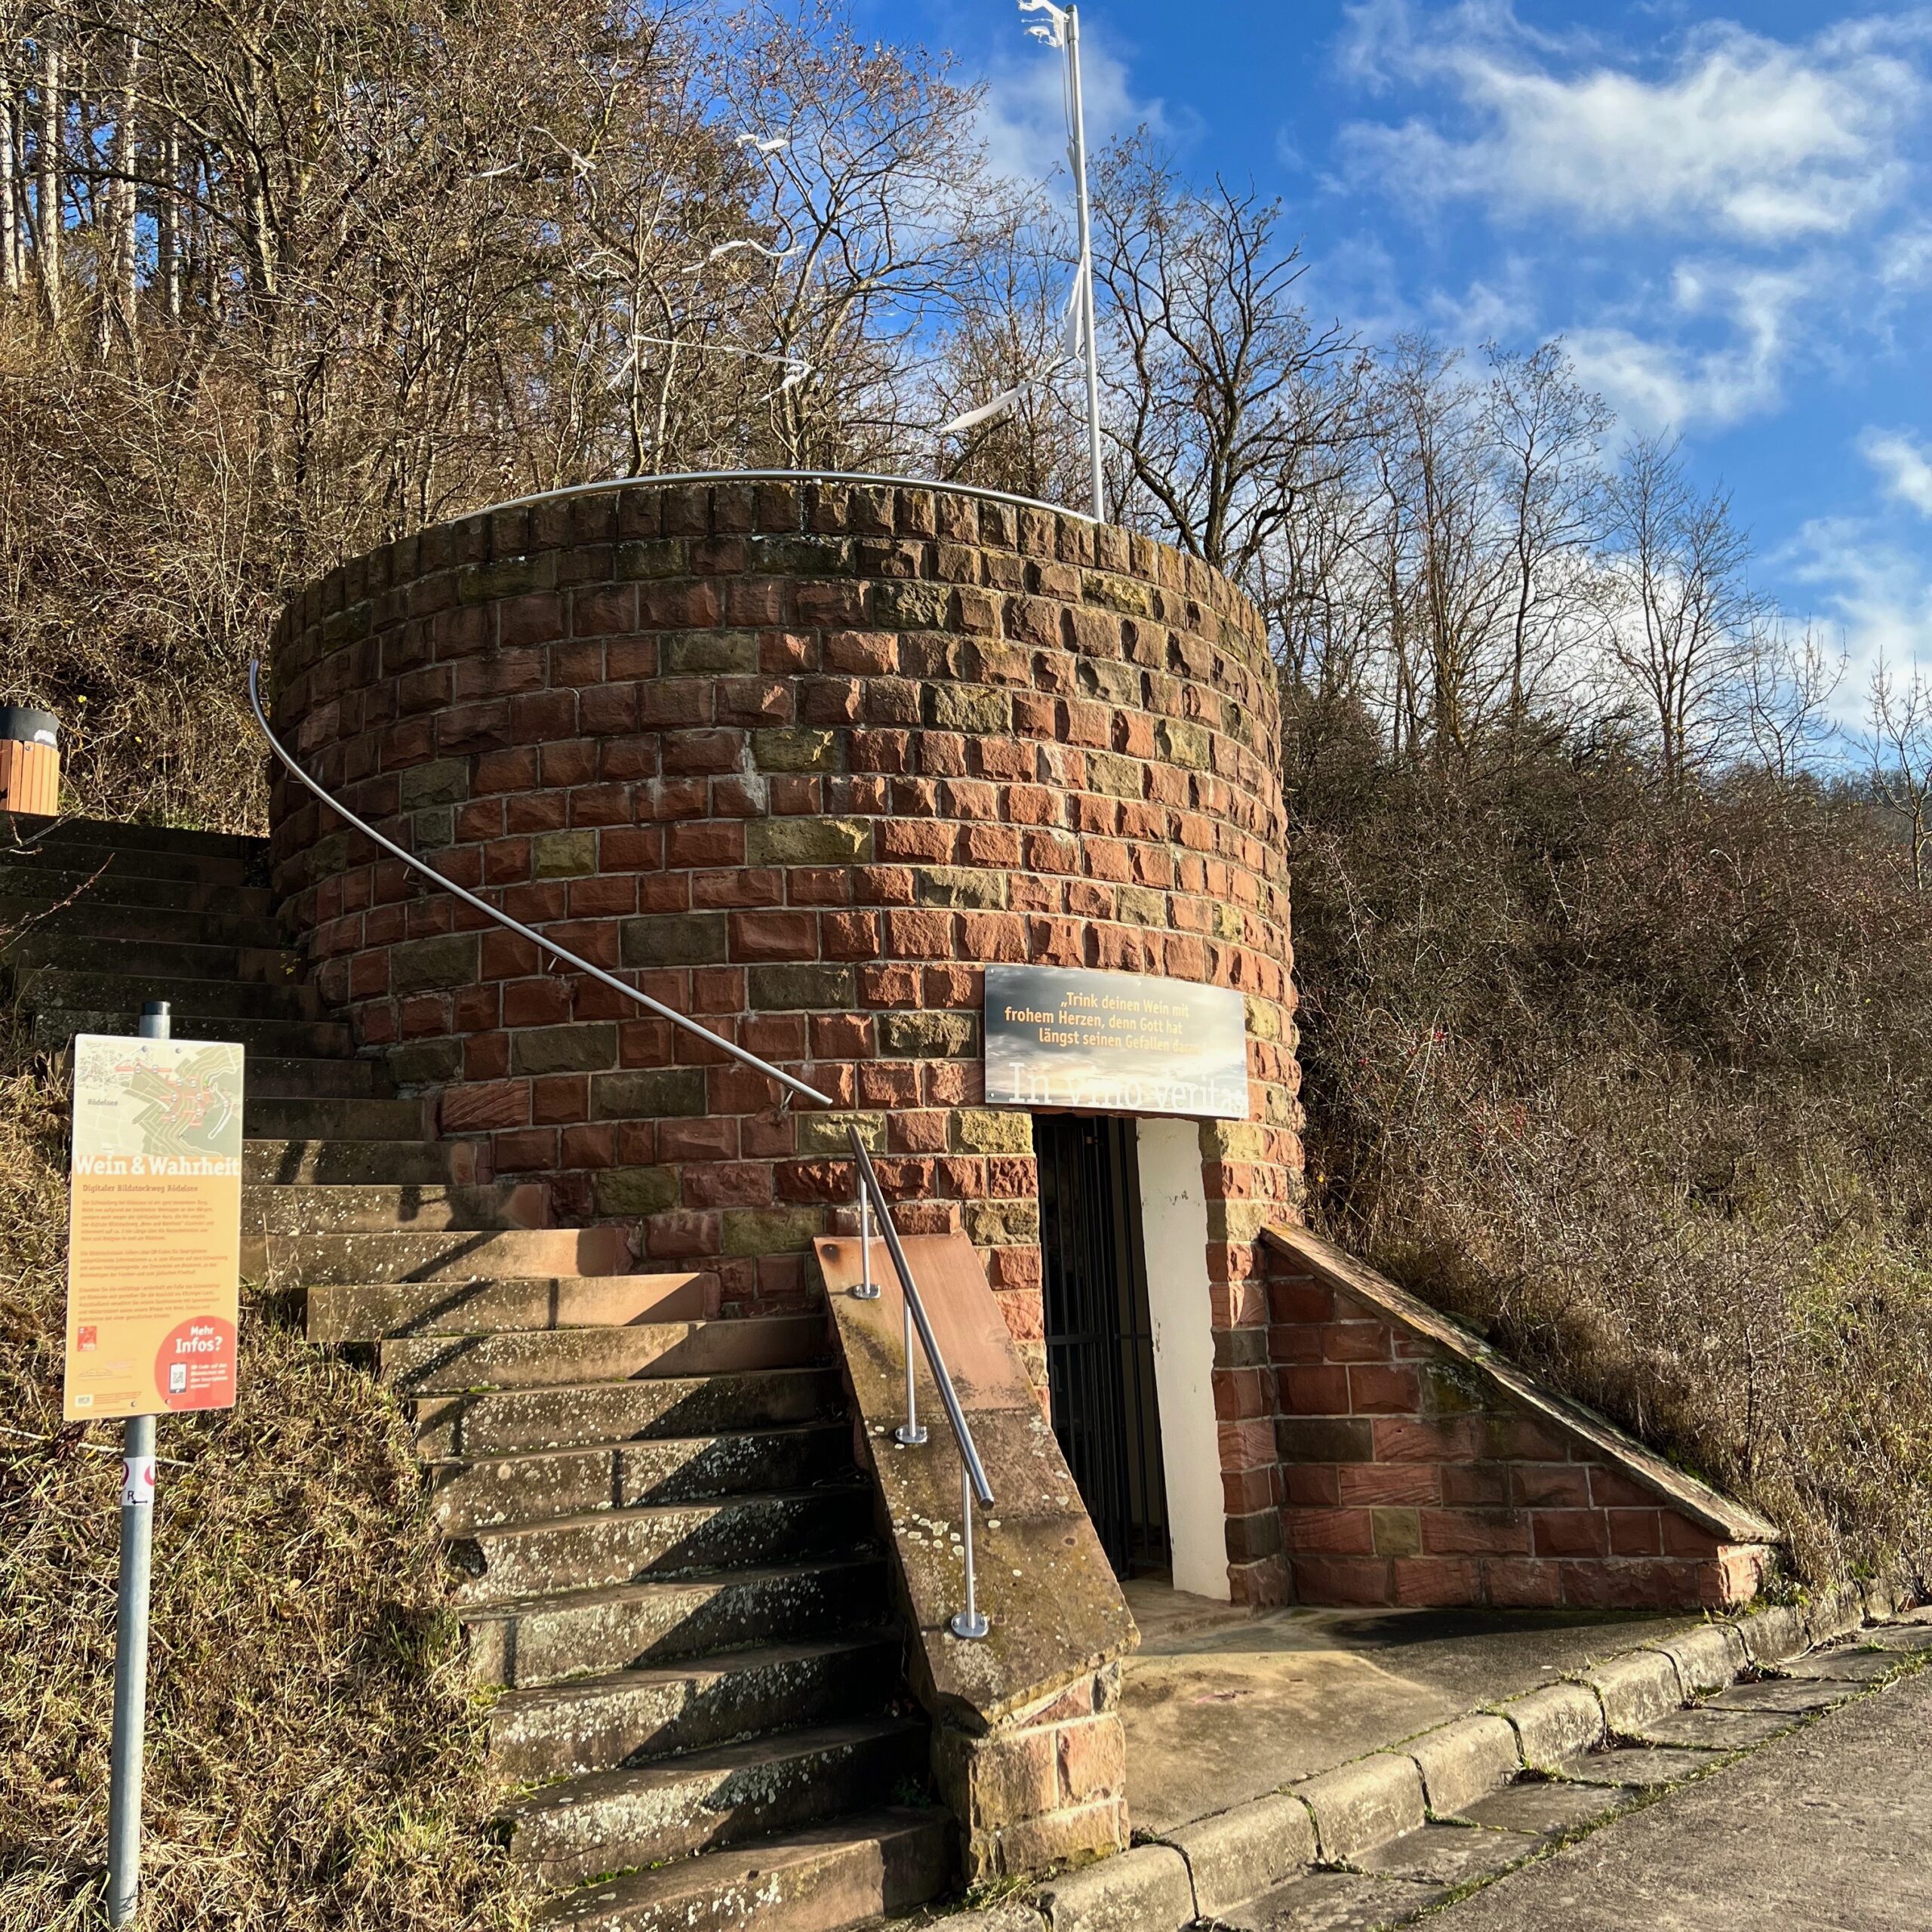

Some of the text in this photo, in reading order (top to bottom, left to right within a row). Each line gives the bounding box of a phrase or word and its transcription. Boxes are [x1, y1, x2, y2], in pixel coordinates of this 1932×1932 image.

[1102, 995, 1140, 1012] deinen
[1143, 999, 1169, 1015] Wein
[1172, 1004, 1190, 1017] mit
[1004, 1006, 1183, 1035] frohem Herzen, denn Gott hat
[1039, 1027, 1080, 1047] längst
[1083, 1032, 1121, 1047] seinen
[1125, 1035, 1170, 1051] Gefallen
[1009, 1062, 1052, 1104] In
[74, 1155, 241, 1177] Wein & Wahrheit
[82, 1184, 198, 1193] Digitaler Bildstockweg Rödelsee
[190, 1325, 214, 1336] Mehr
[175, 1336, 223, 1353] Infos?
[128, 1491, 134, 1500] R
